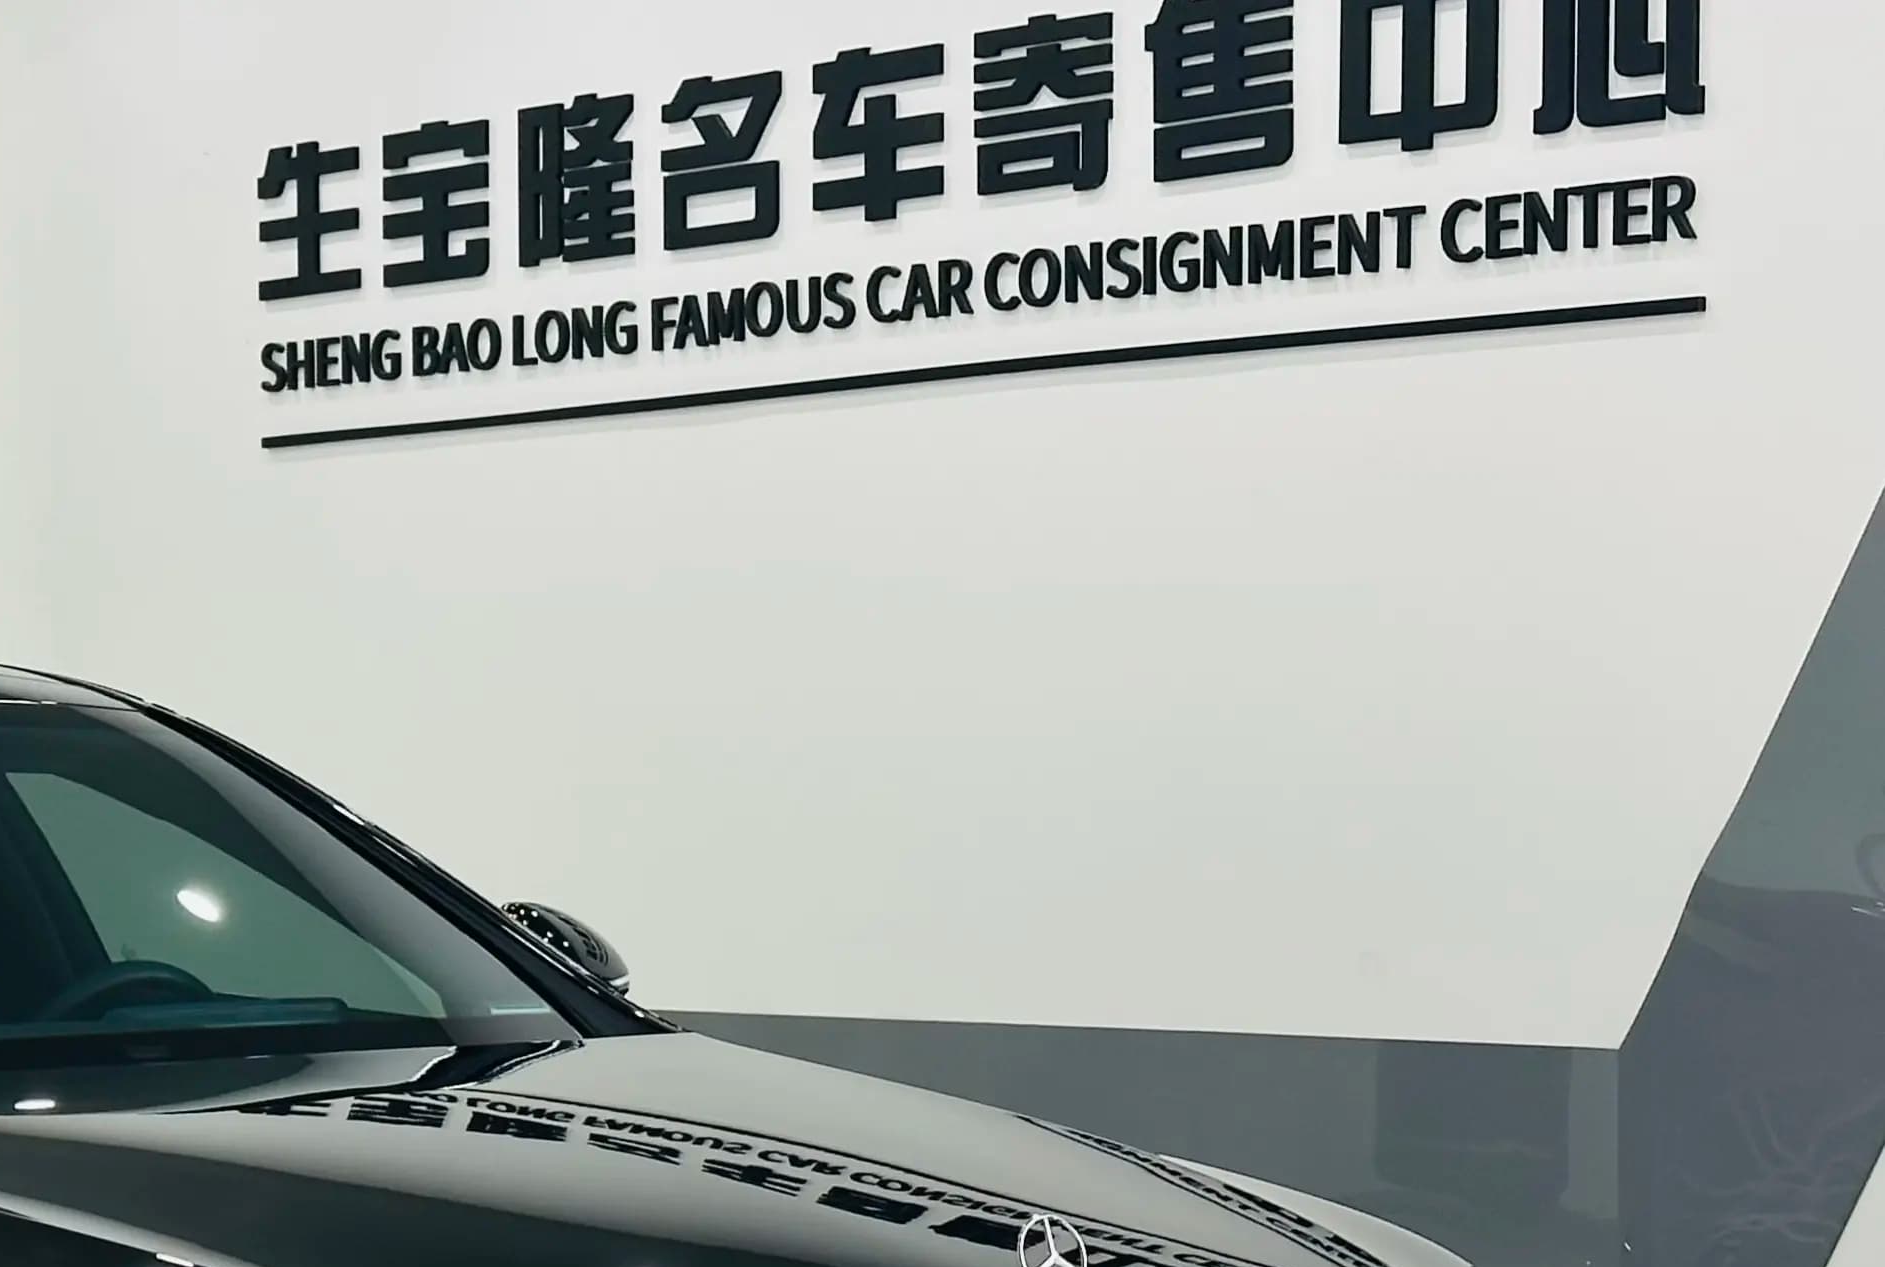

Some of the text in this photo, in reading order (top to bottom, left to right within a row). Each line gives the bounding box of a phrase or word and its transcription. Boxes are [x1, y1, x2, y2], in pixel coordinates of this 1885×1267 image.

[257, 0, 1706, 302] 生宝隆名车寄售中心
[261, 175, 1698, 393] SHENG BAO LONG FAMOUS CAR CONSIGNMENT CENTER
